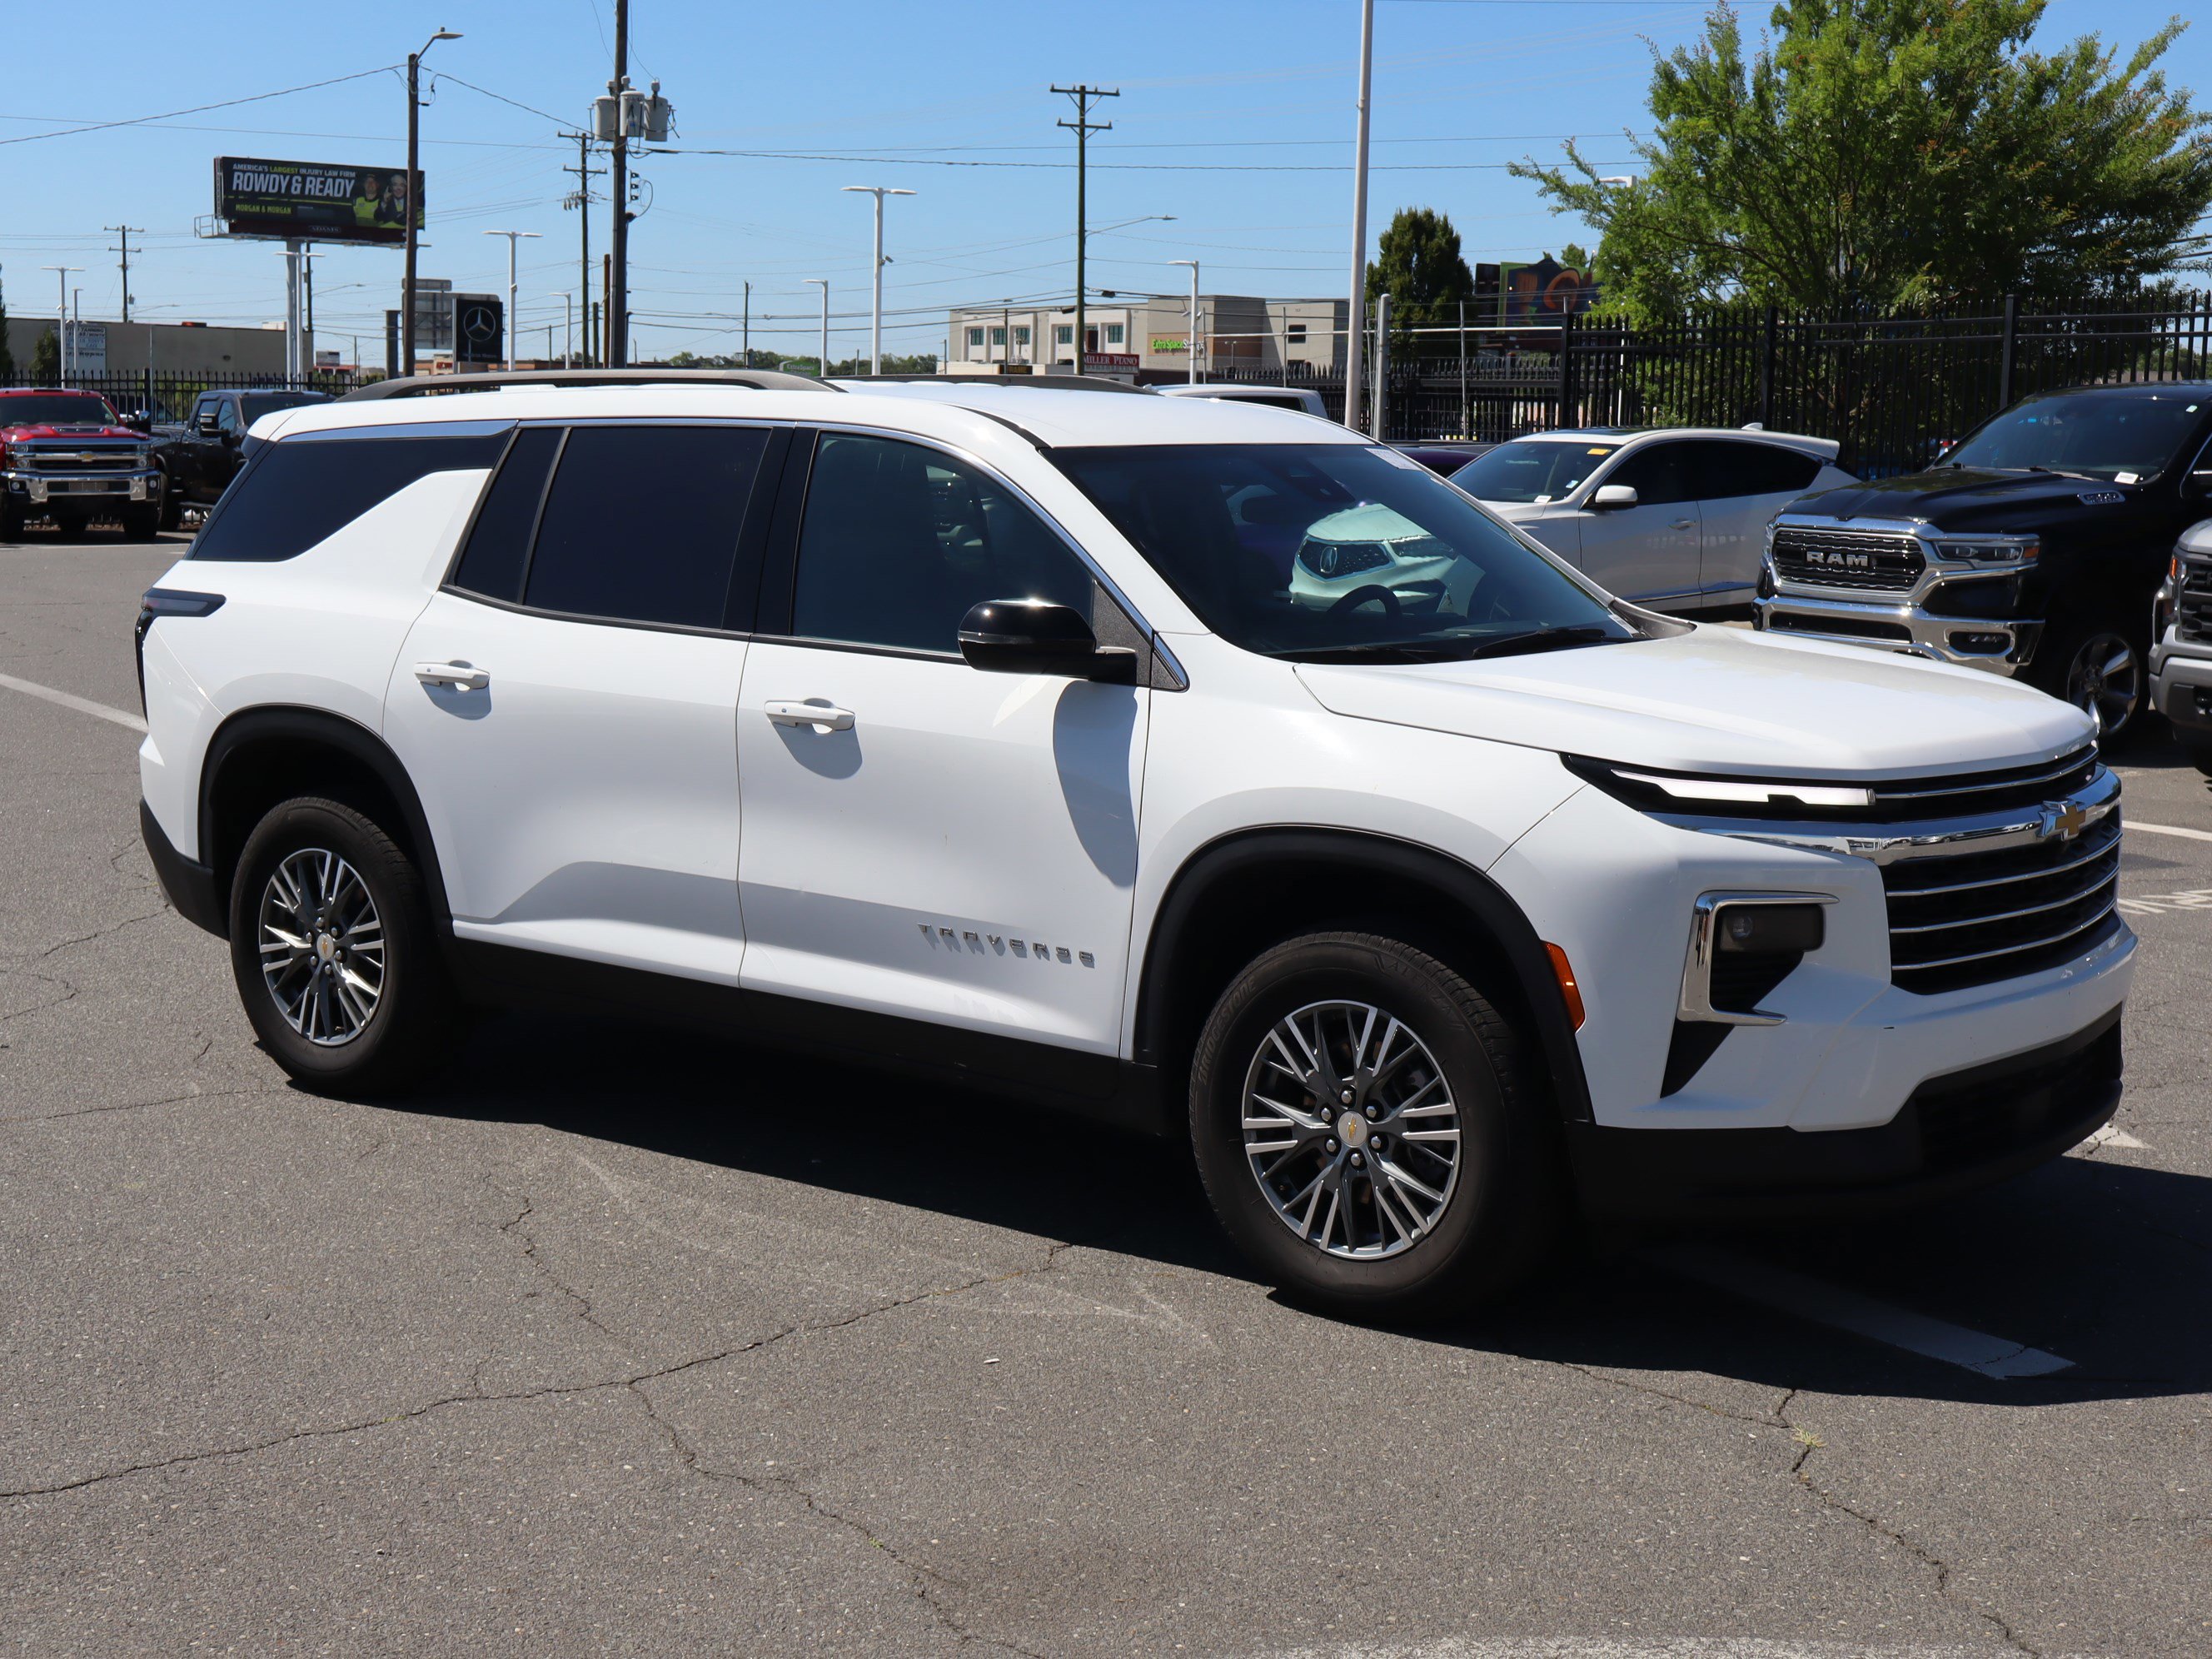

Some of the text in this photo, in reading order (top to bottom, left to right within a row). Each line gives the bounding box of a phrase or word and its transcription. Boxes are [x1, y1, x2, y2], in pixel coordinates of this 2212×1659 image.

[232, 162, 268, 172] AMERICA'S
[270, 166, 298, 174] LARGEST
[299, 167, 323, 176] INJURY
[232, 171, 356, 198] ROWDY & READY
[235, 203, 260, 212] MORGAN
[261, 205, 266, 213] &
[267, 205, 291, 214] MORGAN
[1084, 355, 1137, 365] MILLER PIANO
[1806, 551, 1868, 567] RAM
[917, 923, 1094, 964] TRAVERSE
[1198, 974, 1257, 1085] BRIDGESTONE
